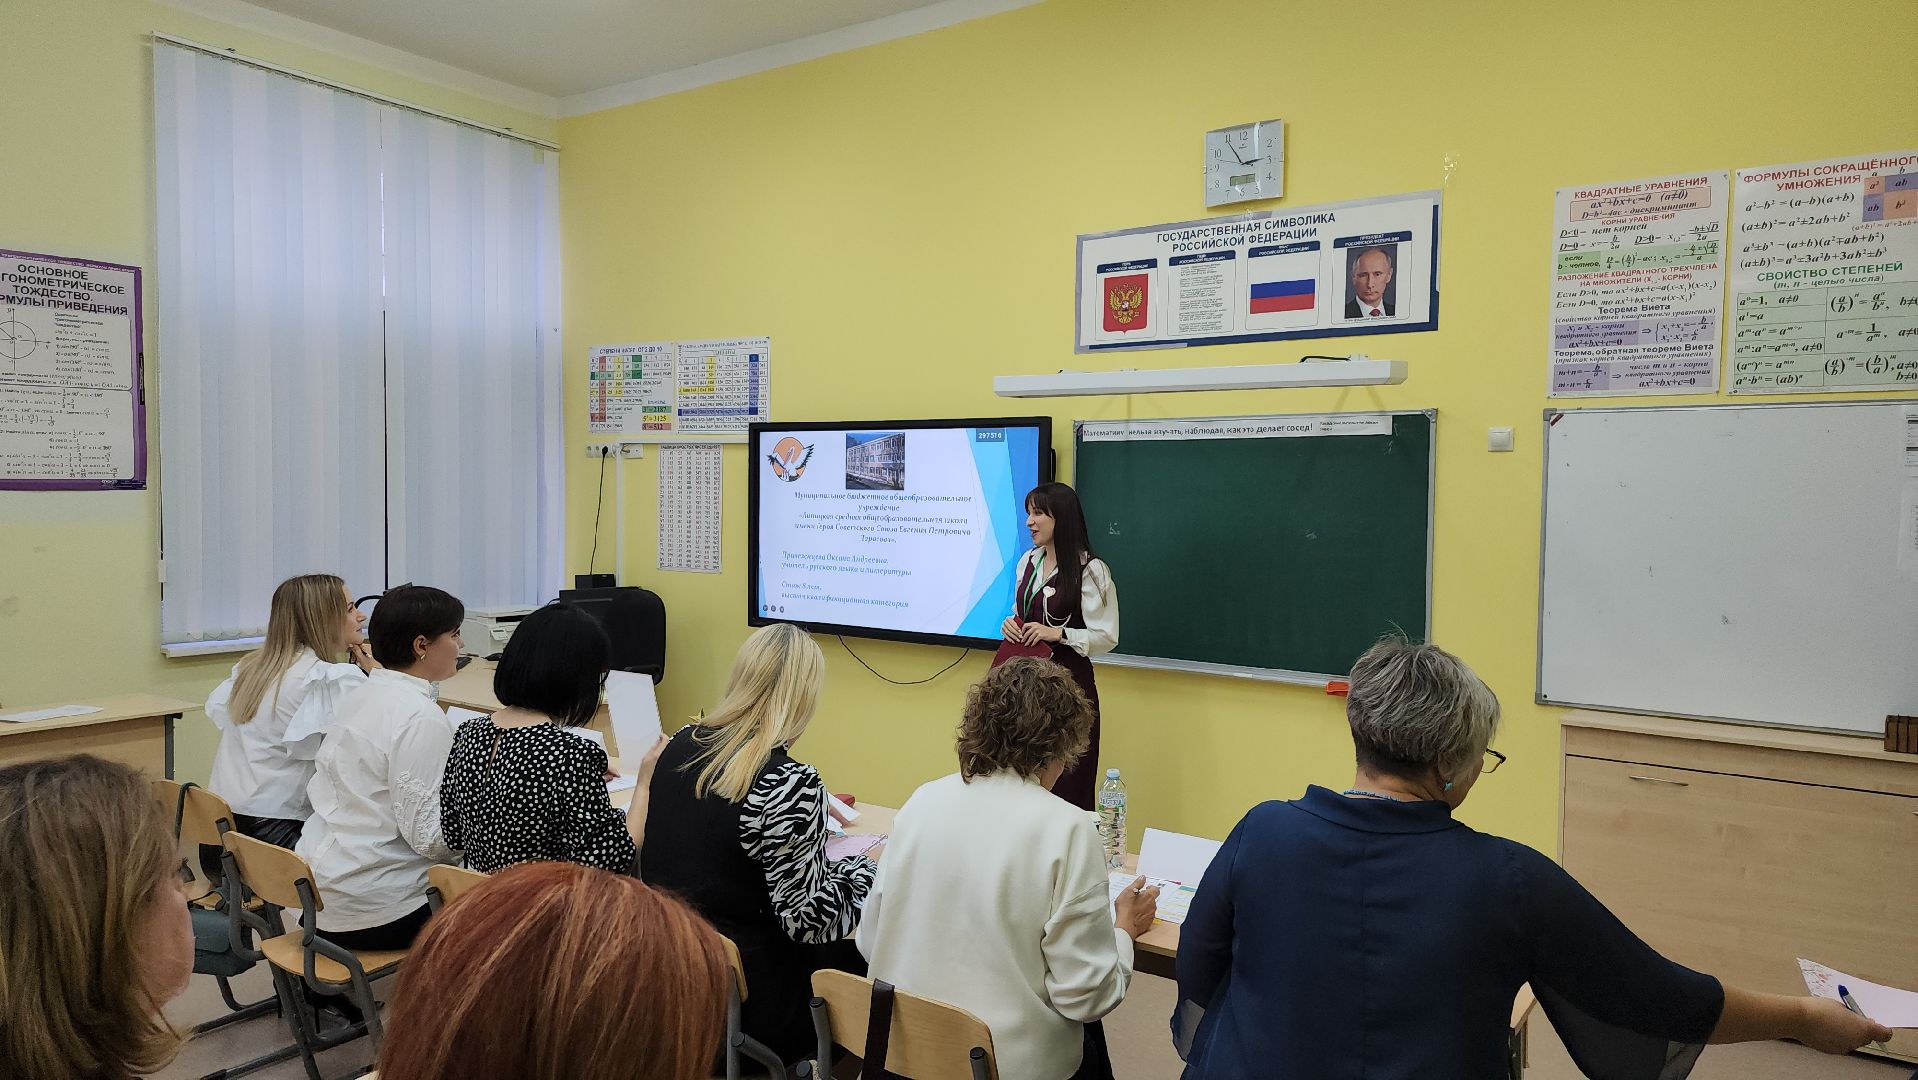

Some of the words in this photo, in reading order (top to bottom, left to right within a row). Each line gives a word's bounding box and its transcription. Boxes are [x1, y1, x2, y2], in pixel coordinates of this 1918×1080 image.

[1225, 134, 1231, 143] 11
[1240, 131, 1248, 140] 12
[1214, 149, 1221, 158] 10
[1744, 168, 1810, 183] ФОРМУЛЫ
[1814, 156, 1918, 176] СОКРАЩЁННОГ
[1574, 184, 1642, 199] КВАДРАТНЫЕ
[1644, 177, 1708, 191] УРАВНЕНИЯ
[1777, 175, 1861, 191] УМНОЖЕНИЯ
[1157, 222, 1260, 243] ГОСУДАРСТВЕННАЯ
[1264, 212, 1336, 230] СИМВОЛИКА
[1172, 234, 1245, 252] РОССИЙСКОЙ
[1249, 228, 1317, 244] ФЕДЕРАЦИИ
[18, 264, 88, 280] ОСНОВНОЕ
[1558, 272, 1609, 281] РАЗЛОЖЕНИЕ
[1757, 268, 1828, 282] СВОЙСТВО
[1832, 261, 1903, 276] СТЕПЕНЕЙ
[2, 273, 125, 294] ГОНОМЕТРИЧЕСКОЕ
[1592, 277, 1642, 286] МНОЖИТЕЛИ
[12, 285, 93, 302] ТОЖДЕСТВО.
[48, 300, 128, 315] ПРИВЕДЕНИЯ
[1598, 306, 1638, 314] Теорема
[1595, 348, 1638, 357] обратная
[1642, 346, 1682, 354] теореме
[1184, 426, 1225, 435] наблюдая,
[1256, 425, 1285, 434] делает
[1286, 423, 1313, 432] сосед!
